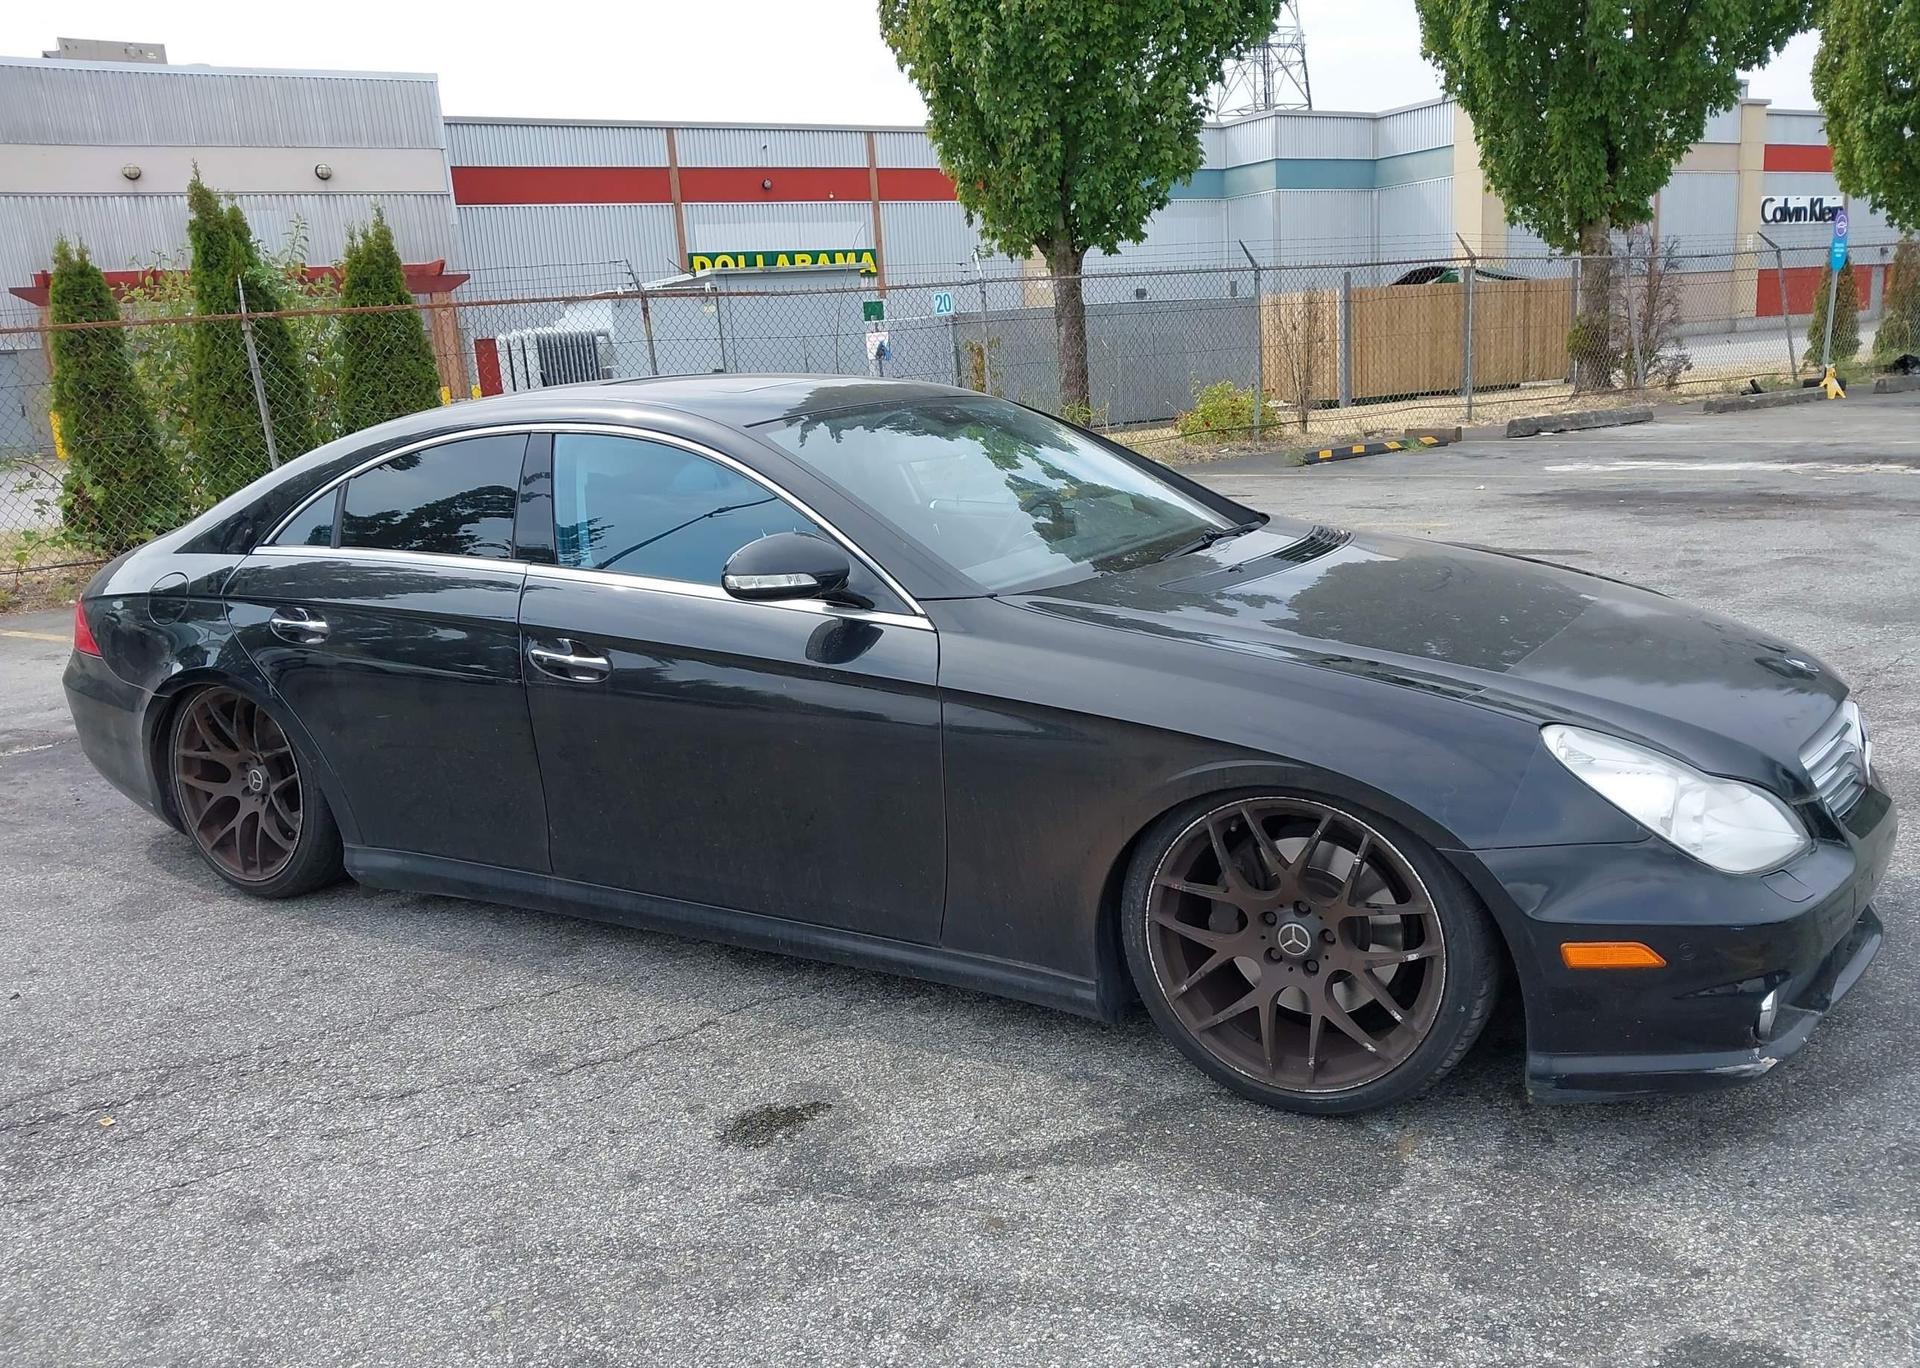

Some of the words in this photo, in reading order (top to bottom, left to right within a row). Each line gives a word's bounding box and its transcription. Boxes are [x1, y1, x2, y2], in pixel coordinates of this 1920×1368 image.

[1761, 197, 1807, 223] Calvin
[693, 252, 877, 273] DOLLARAMA
[935, 293, 952, 313] 20
